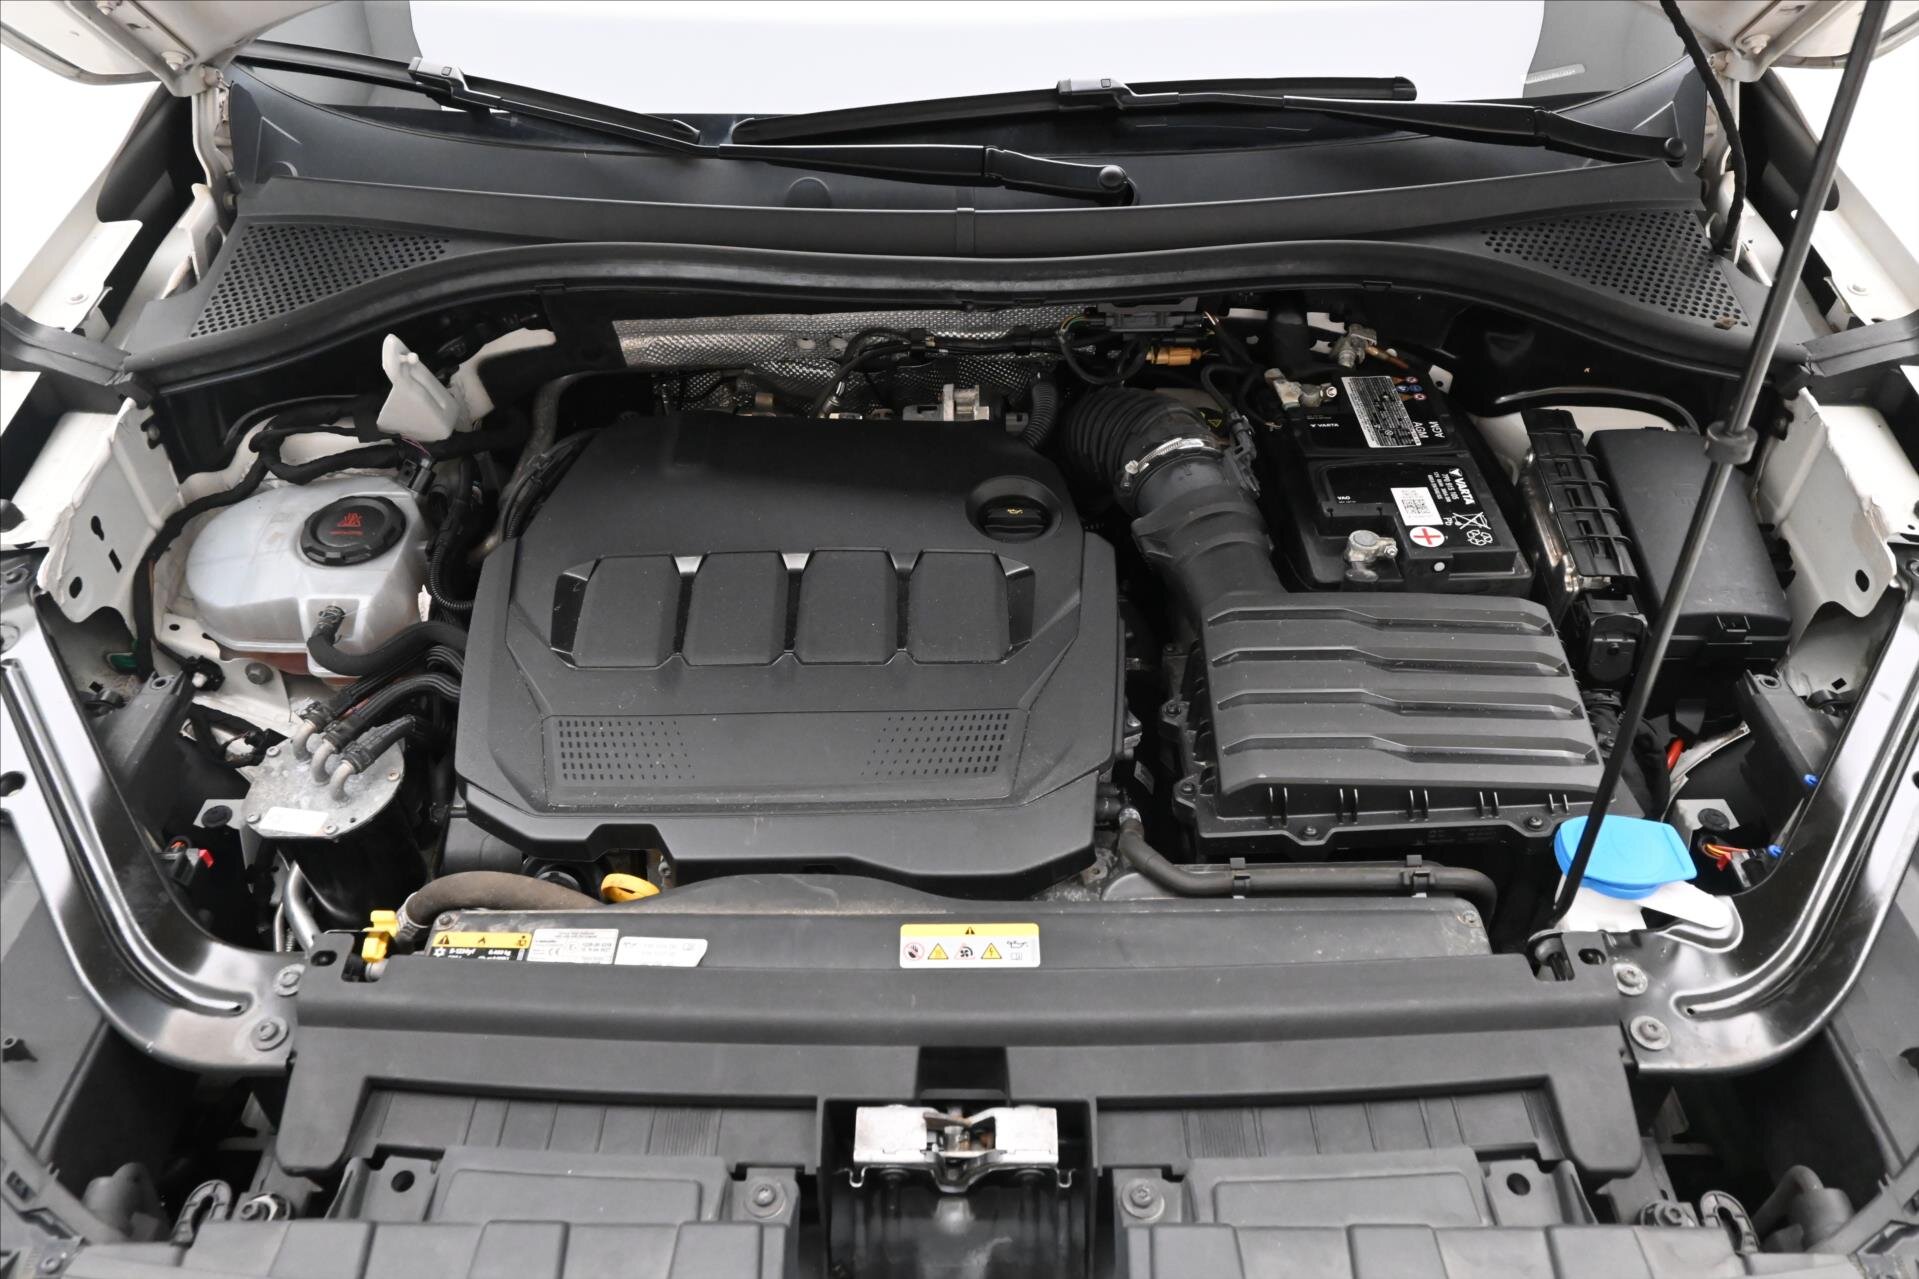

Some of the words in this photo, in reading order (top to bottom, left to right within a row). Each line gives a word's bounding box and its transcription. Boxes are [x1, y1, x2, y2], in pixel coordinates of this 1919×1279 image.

[1412, 421, 1429, 438] AGM
[1428, 421, 1445, 438] AGM
[1454, 477, 1476, 505] VARTA
[1443, 517, 1453, 526] Pb
